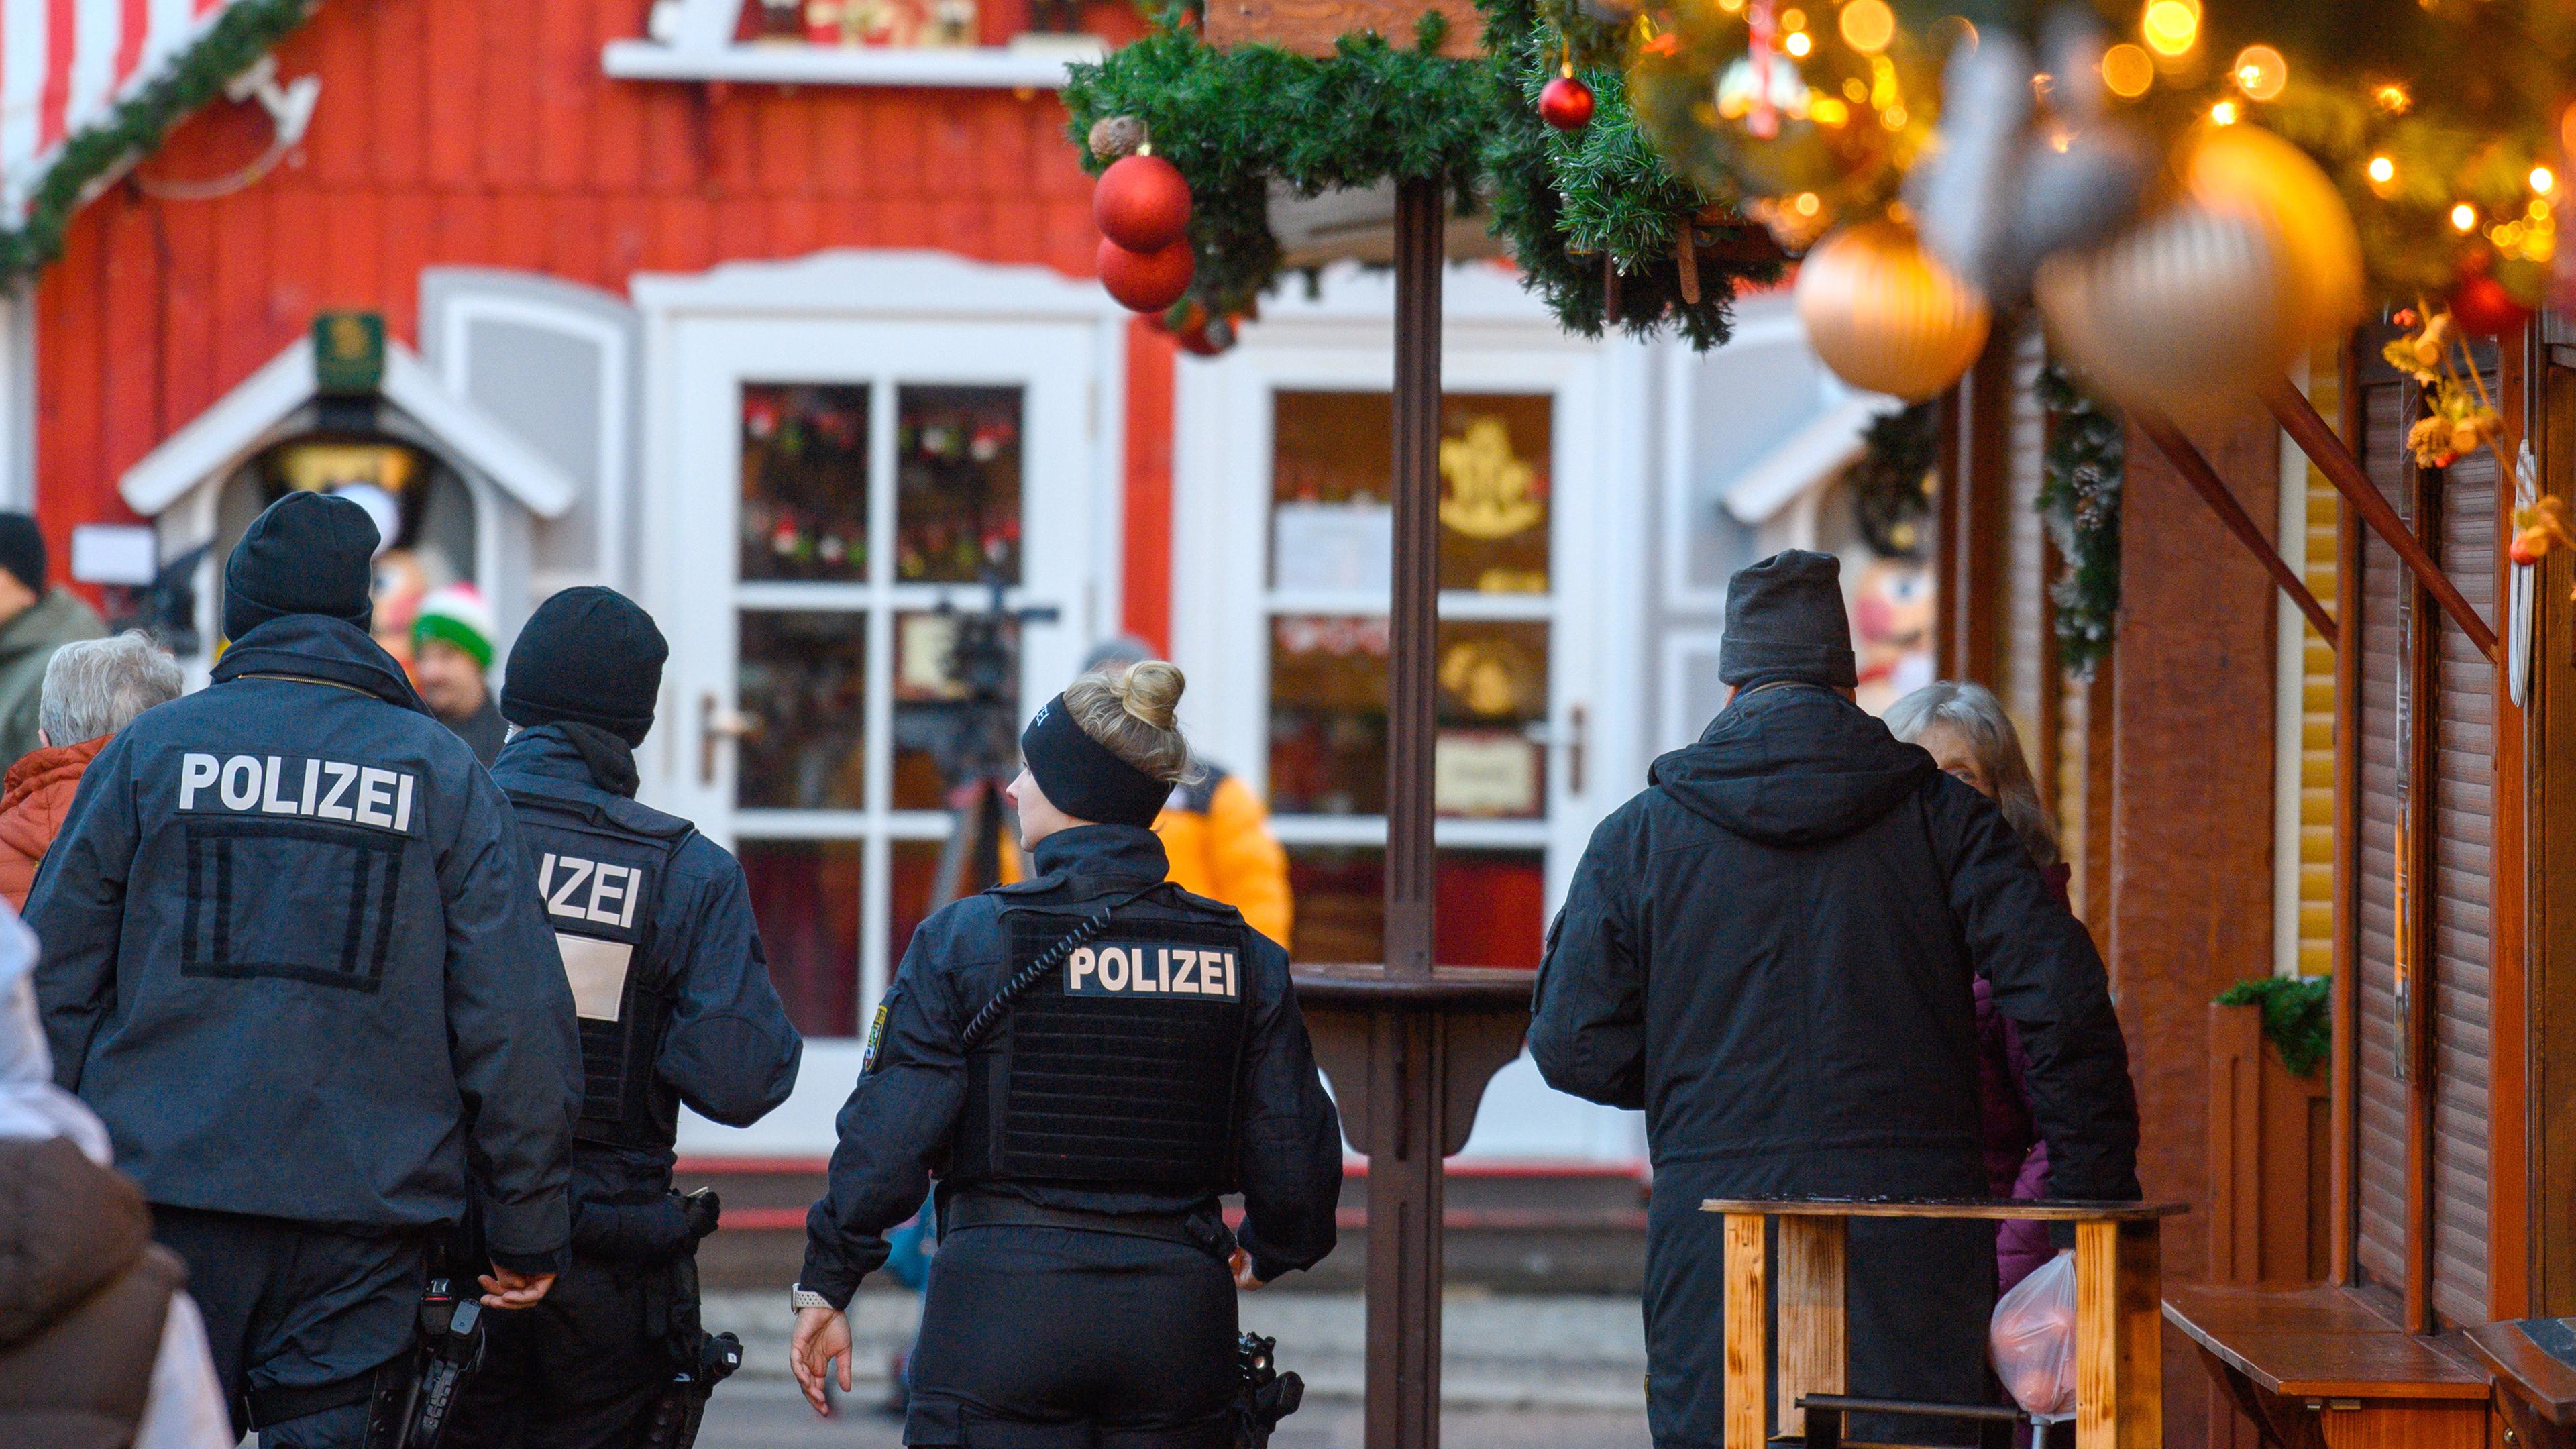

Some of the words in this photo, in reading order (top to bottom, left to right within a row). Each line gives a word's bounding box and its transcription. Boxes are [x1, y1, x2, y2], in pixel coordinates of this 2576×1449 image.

[179, 753, 413, 832] POLIZEI
[538, 853, 641, 928] IZEI
[1069, 947, 1236, 996] POLIZEI
